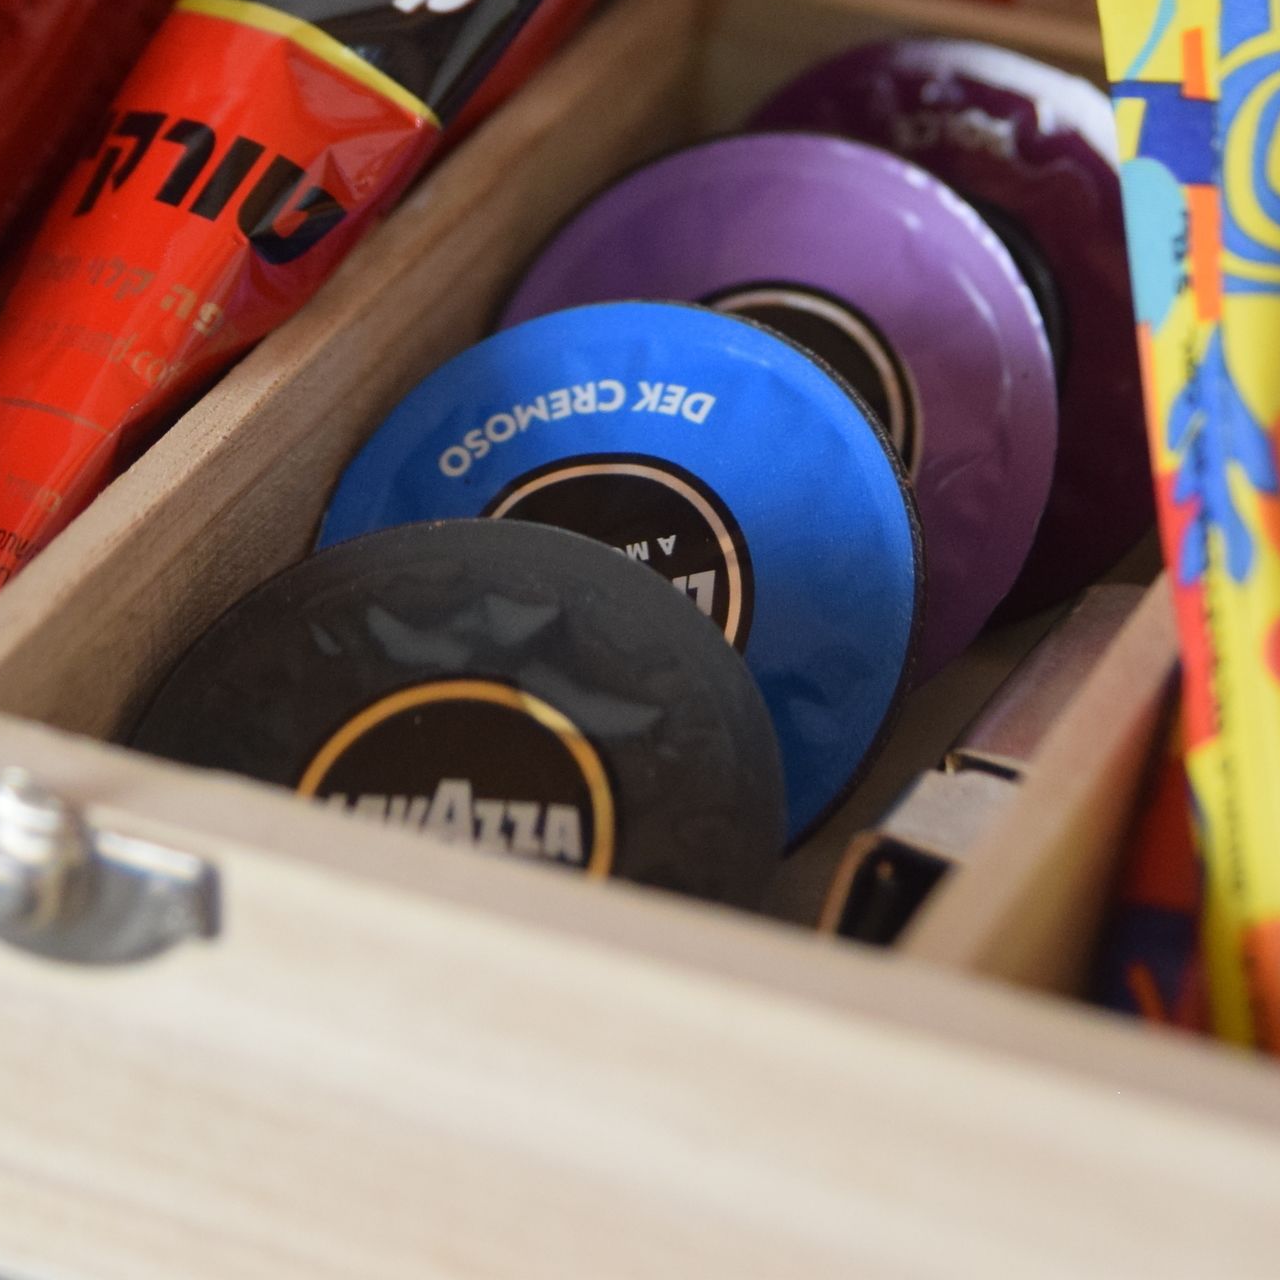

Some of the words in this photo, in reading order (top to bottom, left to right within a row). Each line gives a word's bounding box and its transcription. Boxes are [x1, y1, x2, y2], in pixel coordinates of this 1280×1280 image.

[72, 111, 348, 266] טורק
[438, 379, 626, 477] CREMOSO
[632, 380, 716, 425] DEK
